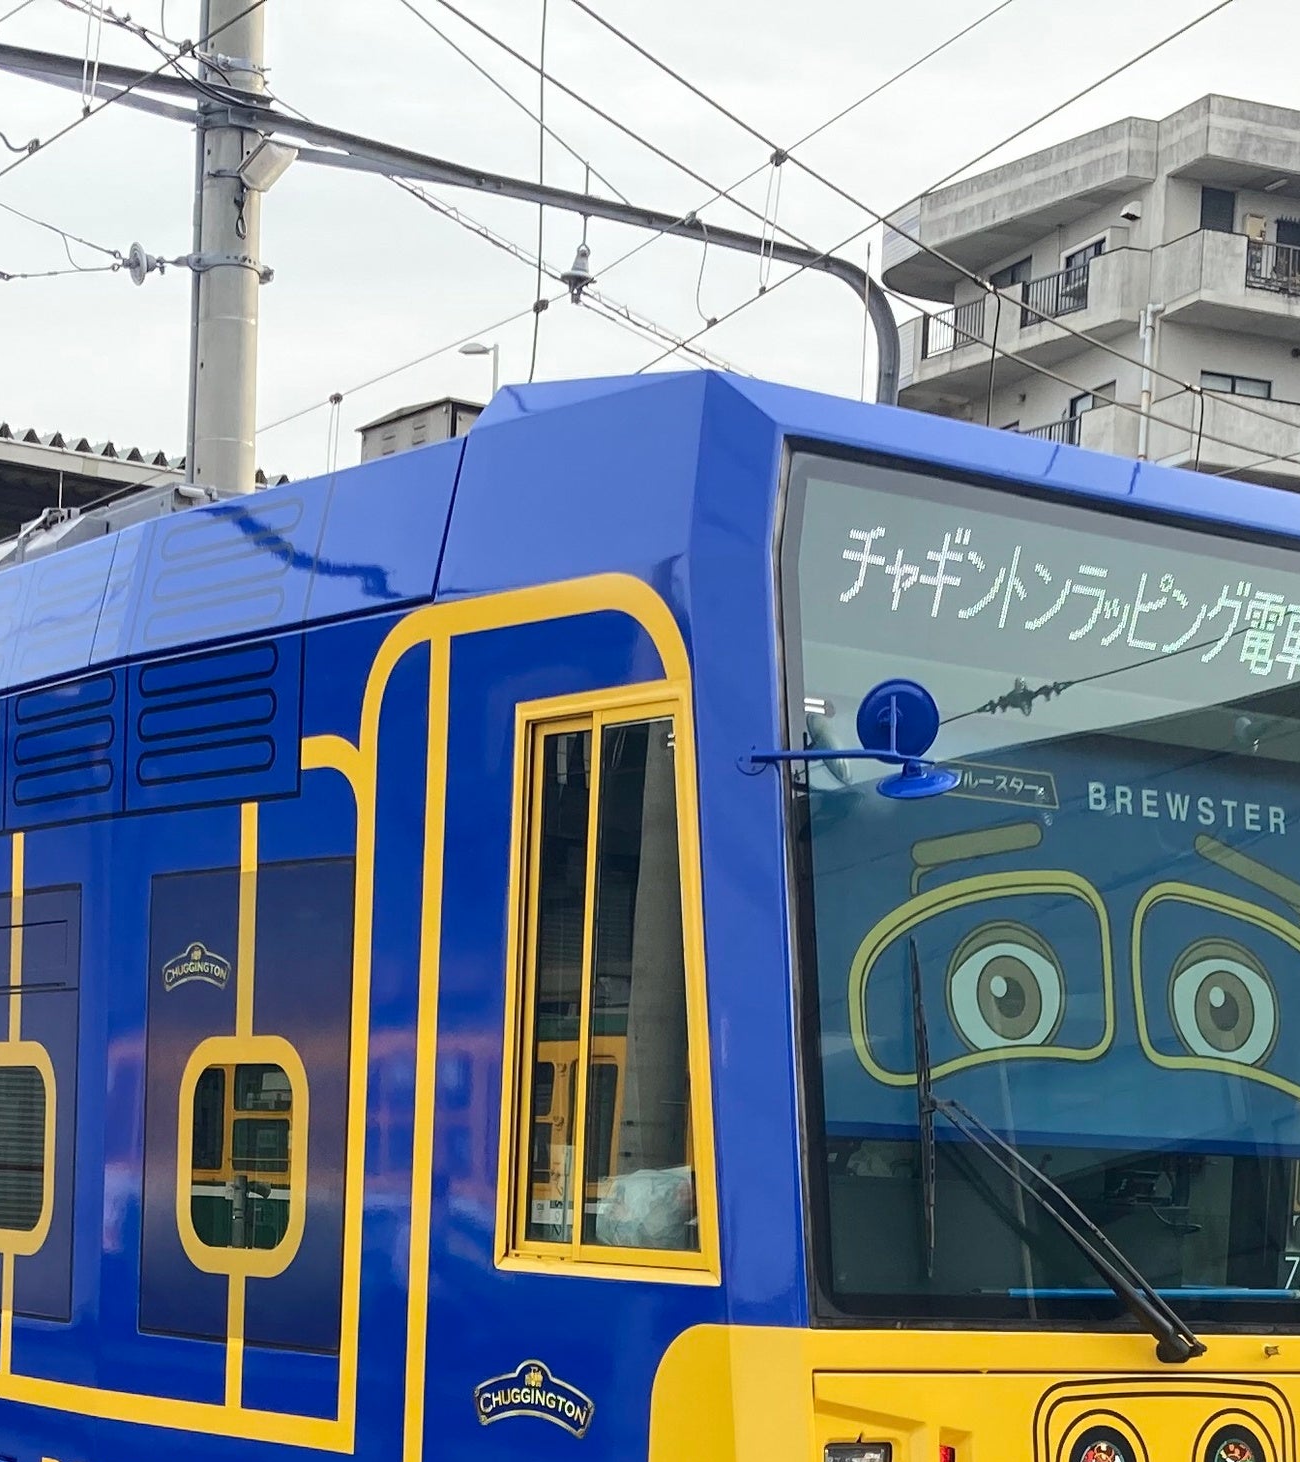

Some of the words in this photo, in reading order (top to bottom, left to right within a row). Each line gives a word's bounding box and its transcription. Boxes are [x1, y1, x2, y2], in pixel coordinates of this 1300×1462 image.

[958, 770, 1040, 796] ルースター
[1087, 781, 1286, 835] BREWSTER
[165, 961, 226, 983] CHUGGINGTON
[480, 1387, 588, 1426] CHUGGINGTON
